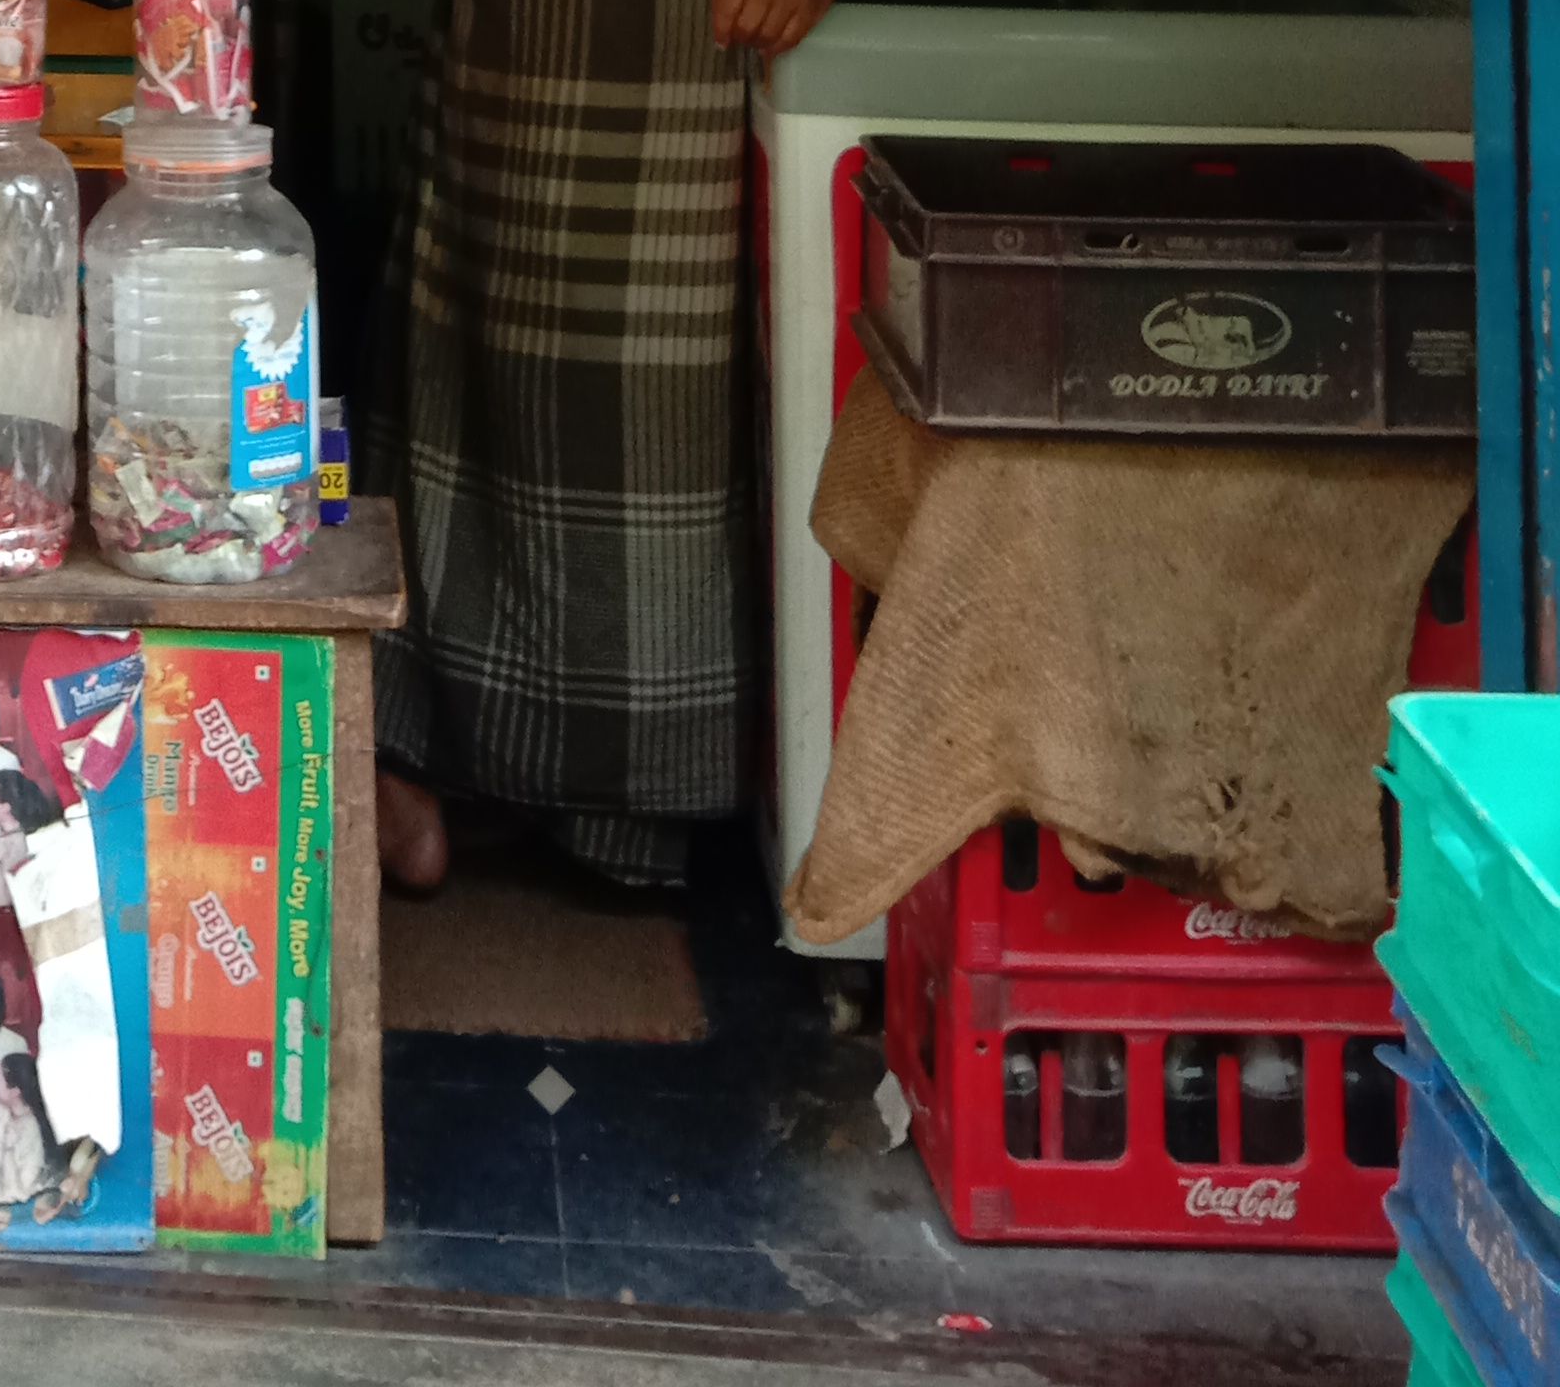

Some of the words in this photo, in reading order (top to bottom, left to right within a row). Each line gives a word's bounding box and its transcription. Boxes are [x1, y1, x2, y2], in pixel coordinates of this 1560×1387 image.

[198, 703, 259, 789] BEJOIS
[295, 699, 315, 747] More
[160, 740, 183, 813] Mango
[295, 817, 314, 864] More
[194, 896, 254, 983] BEJOIS
[287, 918, 311, 978] More
[189, 1092, 250, 1180] BEJOIS
